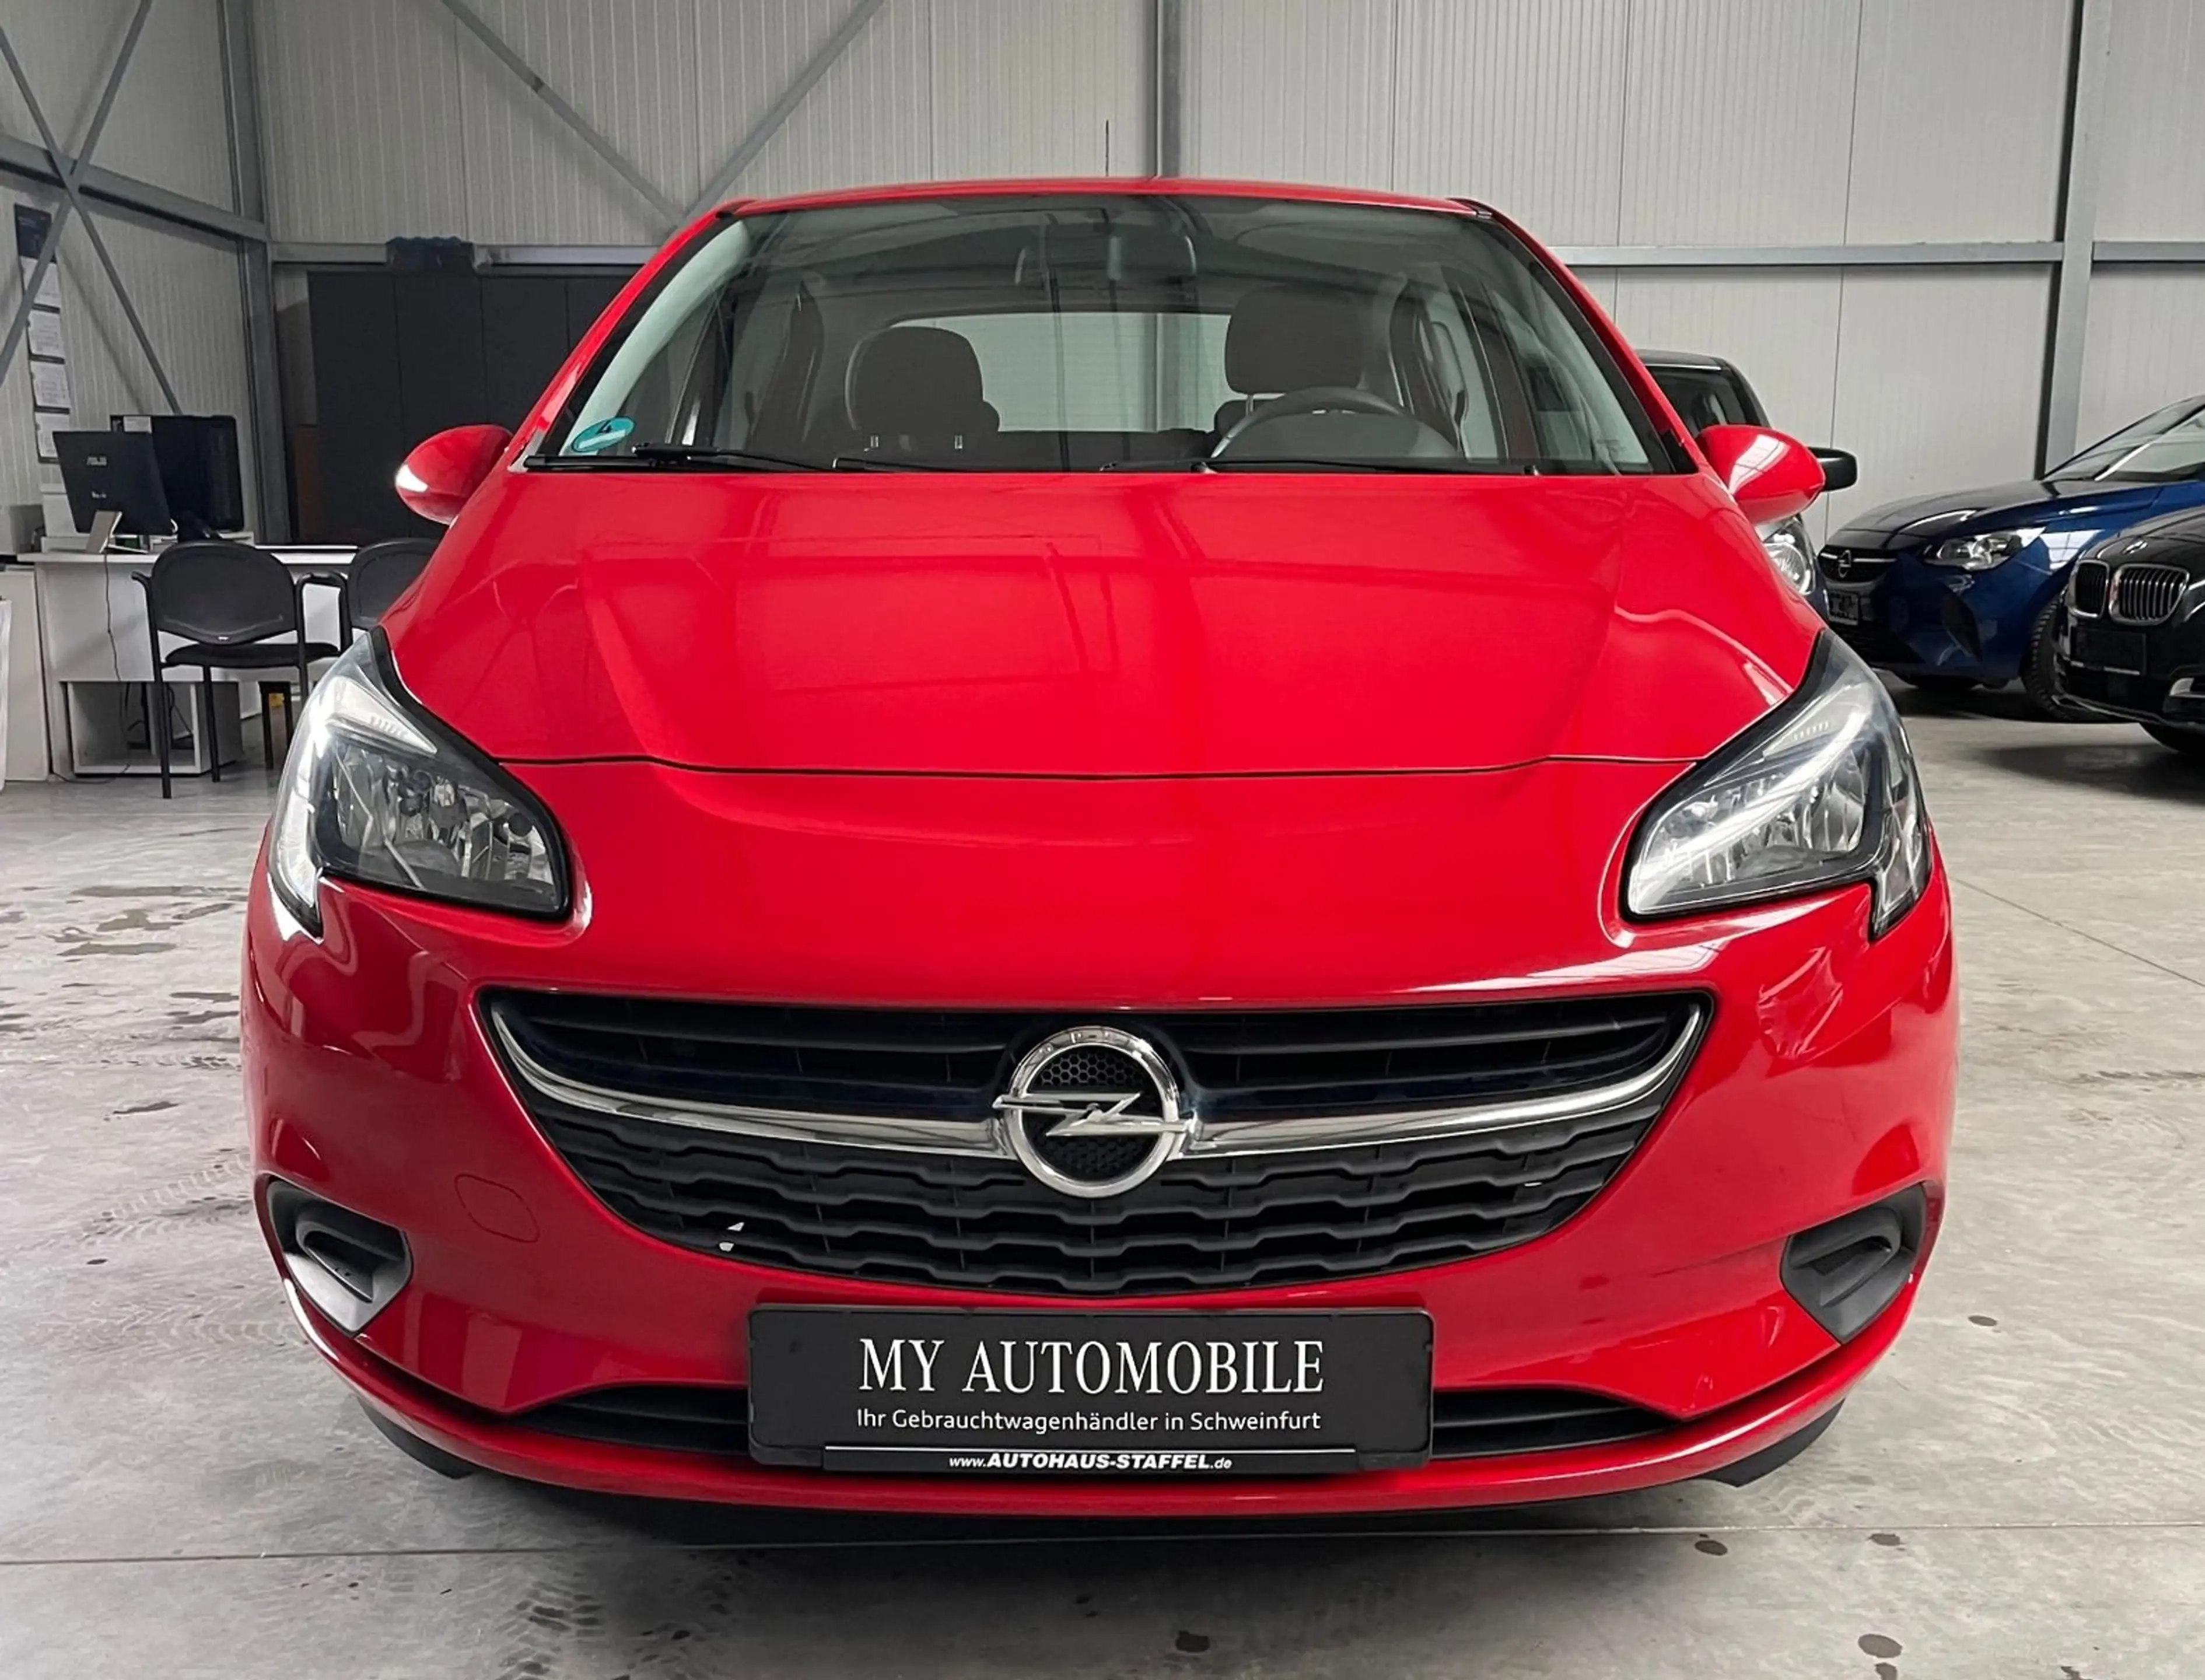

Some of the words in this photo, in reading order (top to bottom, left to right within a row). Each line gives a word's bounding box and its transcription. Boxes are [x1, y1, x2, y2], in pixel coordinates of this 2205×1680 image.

[859, 1338, 944, 1392] MY
[961, 1340, 1324, 1394] AUTOMOBILE
[858, 1408, 887, 1427] Ihr
[892, 1409, 1158, 1434] Gebrauchtwagenhändler
[1165, 1412, 1184, 1430] in
[1190, 1410, 1321, 1431] Schweinfurt
[949, 1452, 1232, 1469] www.AUTOHAUS-STAFFEL.de
